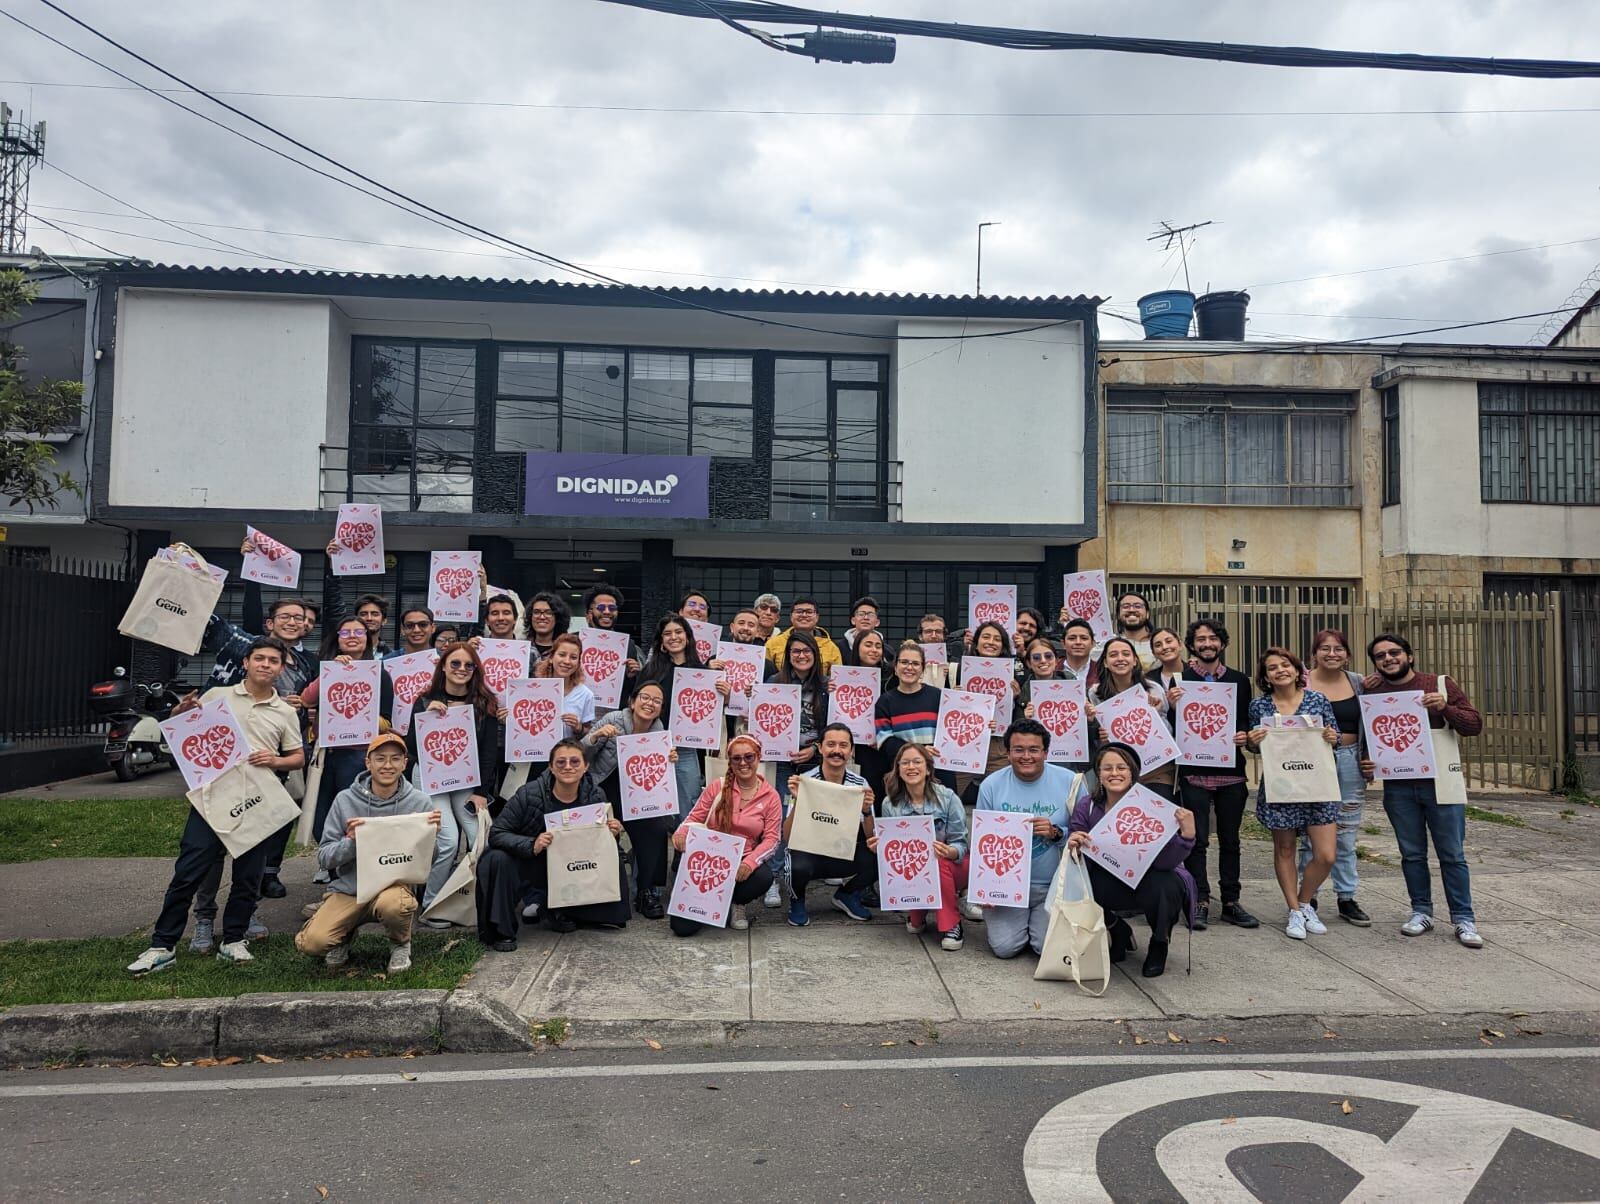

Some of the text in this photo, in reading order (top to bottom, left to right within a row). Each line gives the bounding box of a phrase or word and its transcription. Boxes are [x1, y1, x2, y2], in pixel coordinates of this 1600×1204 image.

[557, 476, 672, 496] DIGNIDAD
[155, 598, 188, 616] Gente
[1282, 762, 1314, 770] Gente
[811, 812, 839, 824] Gente
[378, 855, 413, 865] Gente
[567, 862, 597, 872] Gente
